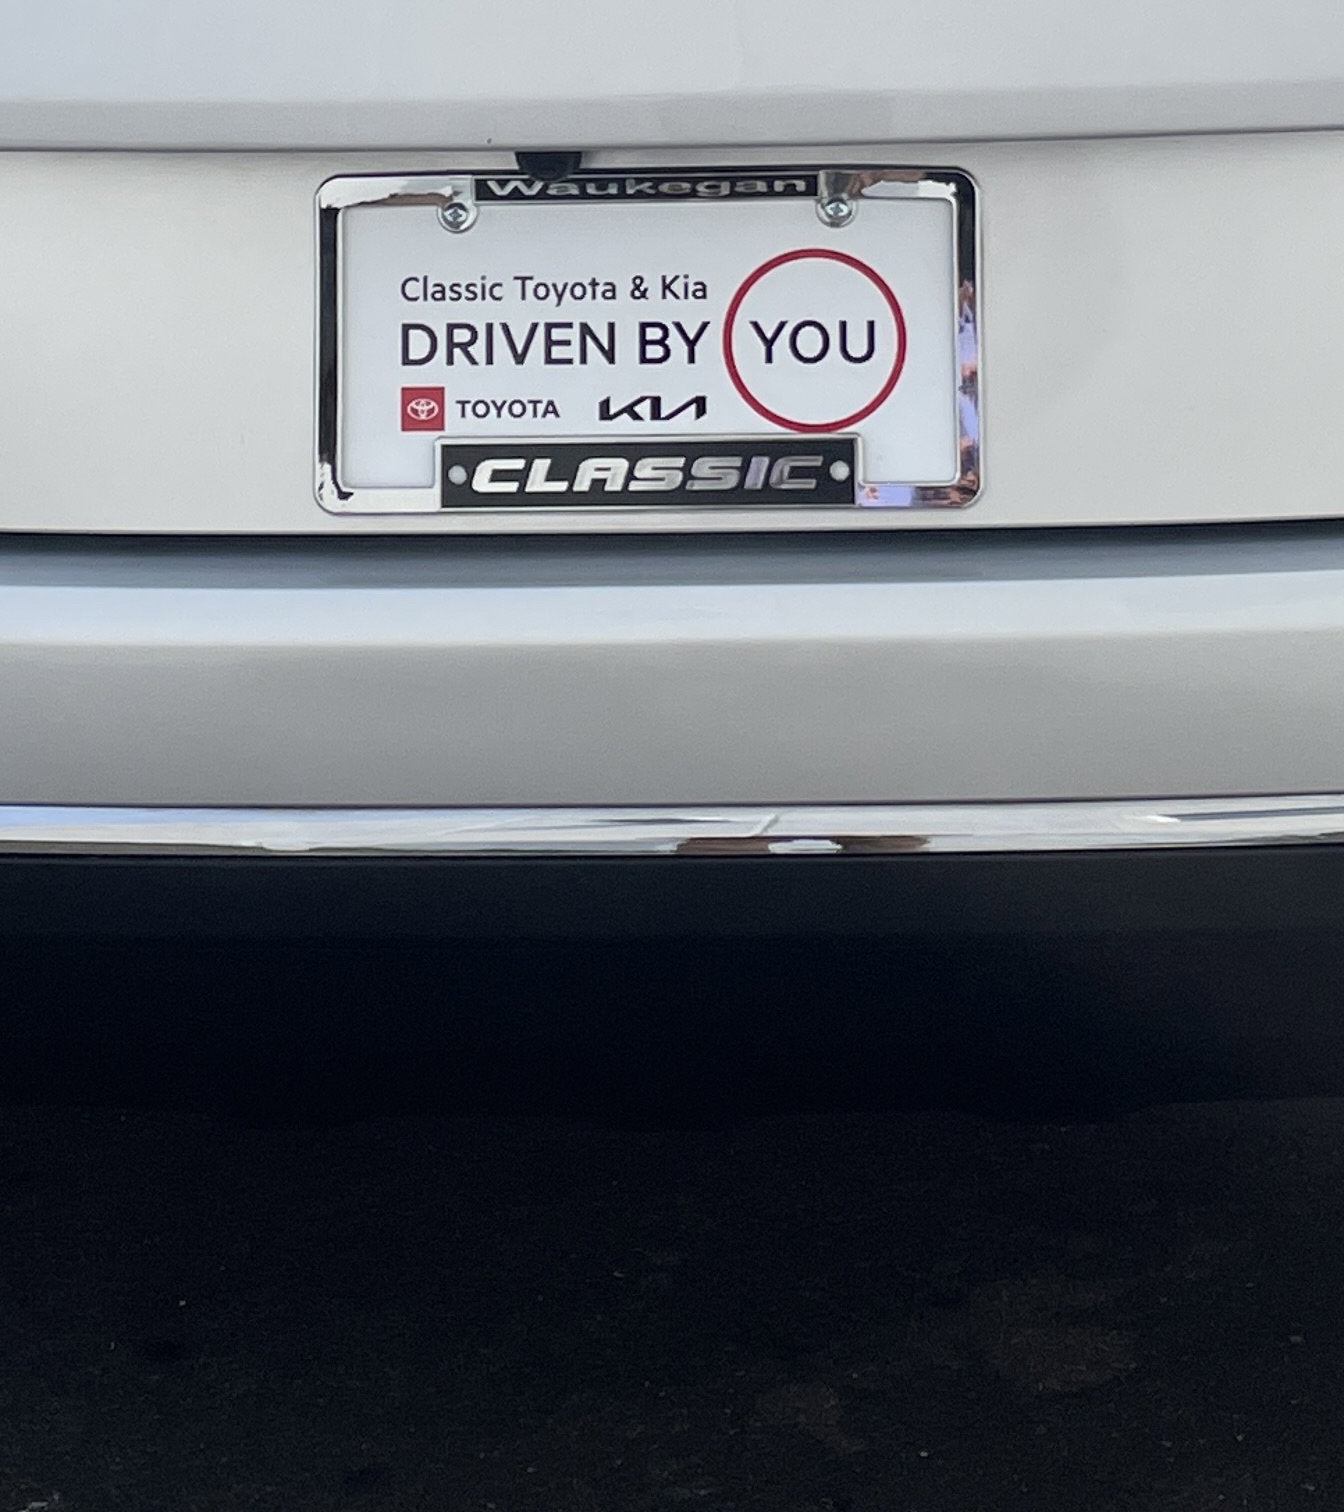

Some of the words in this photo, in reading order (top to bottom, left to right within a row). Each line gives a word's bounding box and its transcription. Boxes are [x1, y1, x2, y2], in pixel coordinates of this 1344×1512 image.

[401, 275, 504, 303] Classic
[513, 275, 617, 308] Toyota
[630, 276, 649, 301] &
[662, 274, 708, 301] Kia
[400, 322, 617, 367] DRIVEN
[638, 321, 711, 365] BY
[750, 320, 875, 364] YOU
[455, 400, 560, 420] TOYOTA
[470, 455, 824, 493] CLASSIC
